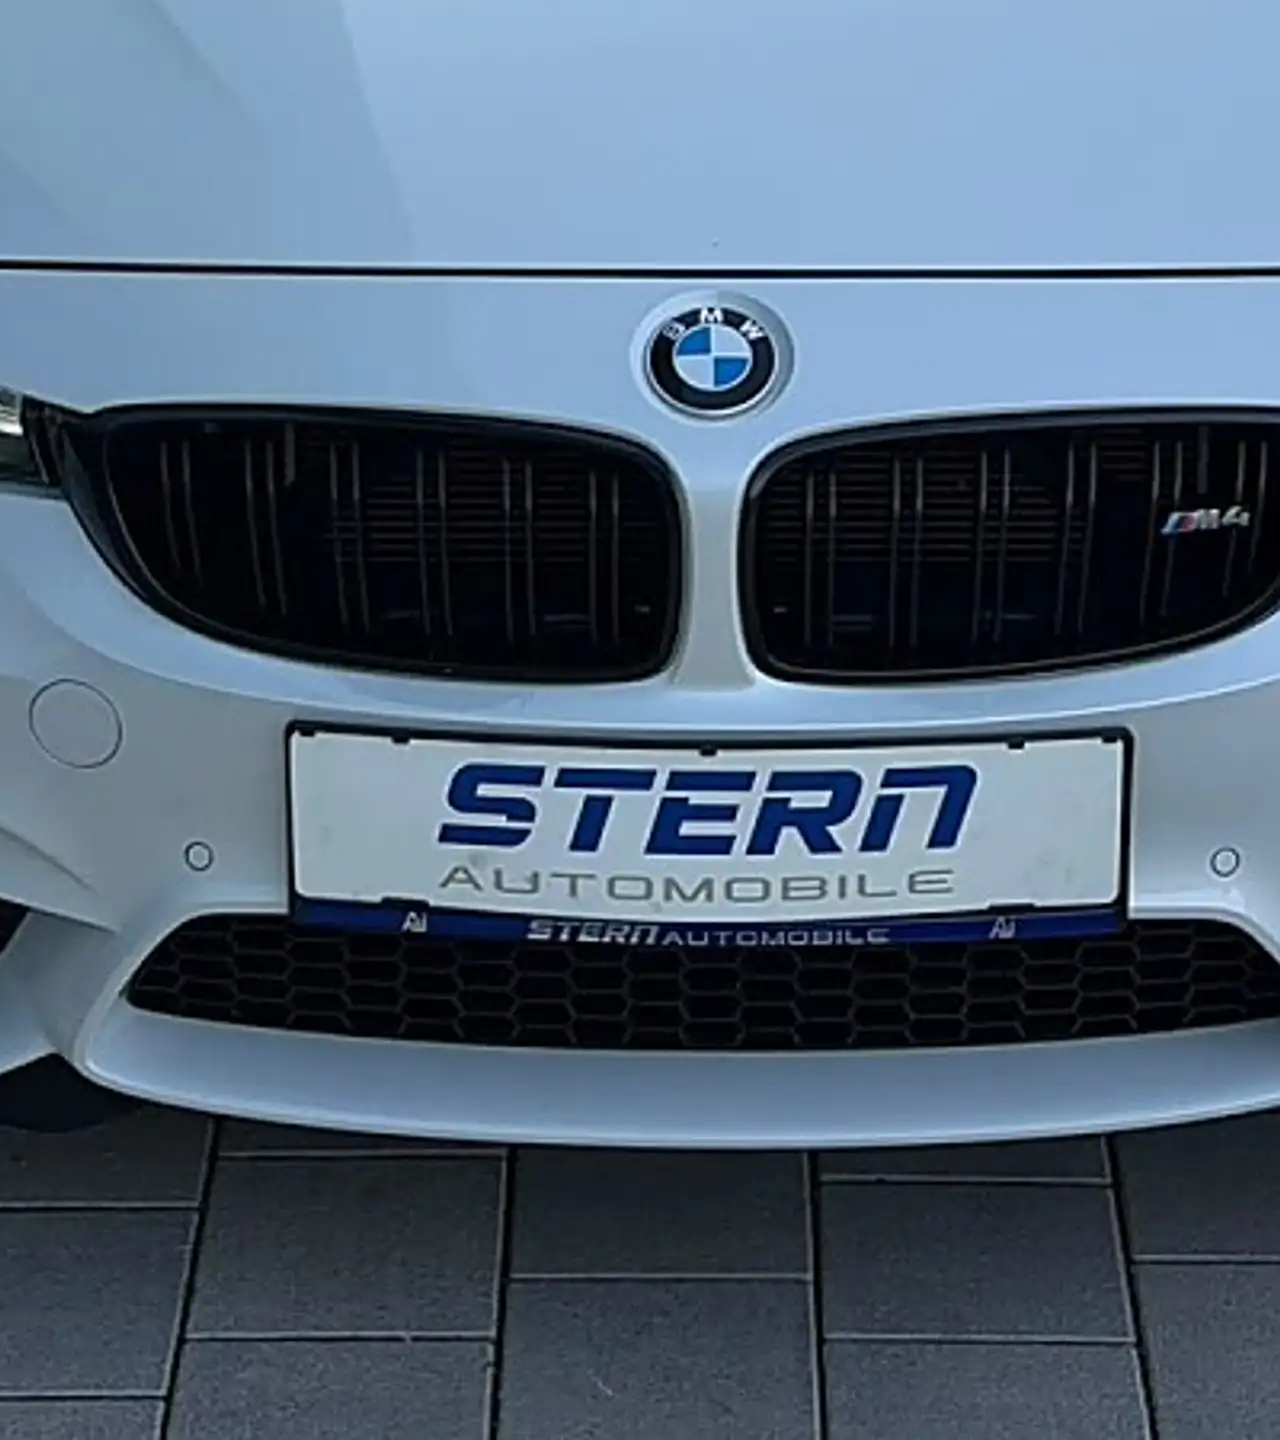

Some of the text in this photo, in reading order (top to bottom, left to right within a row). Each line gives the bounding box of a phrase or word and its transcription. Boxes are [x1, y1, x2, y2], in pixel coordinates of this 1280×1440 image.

[662, 307, 766, 340] BMW
[1161, 505, 1250, 535] M4
[437, 762, 979, 857] STERN
[438, 865, 956, 906] AUTOMOBILE
